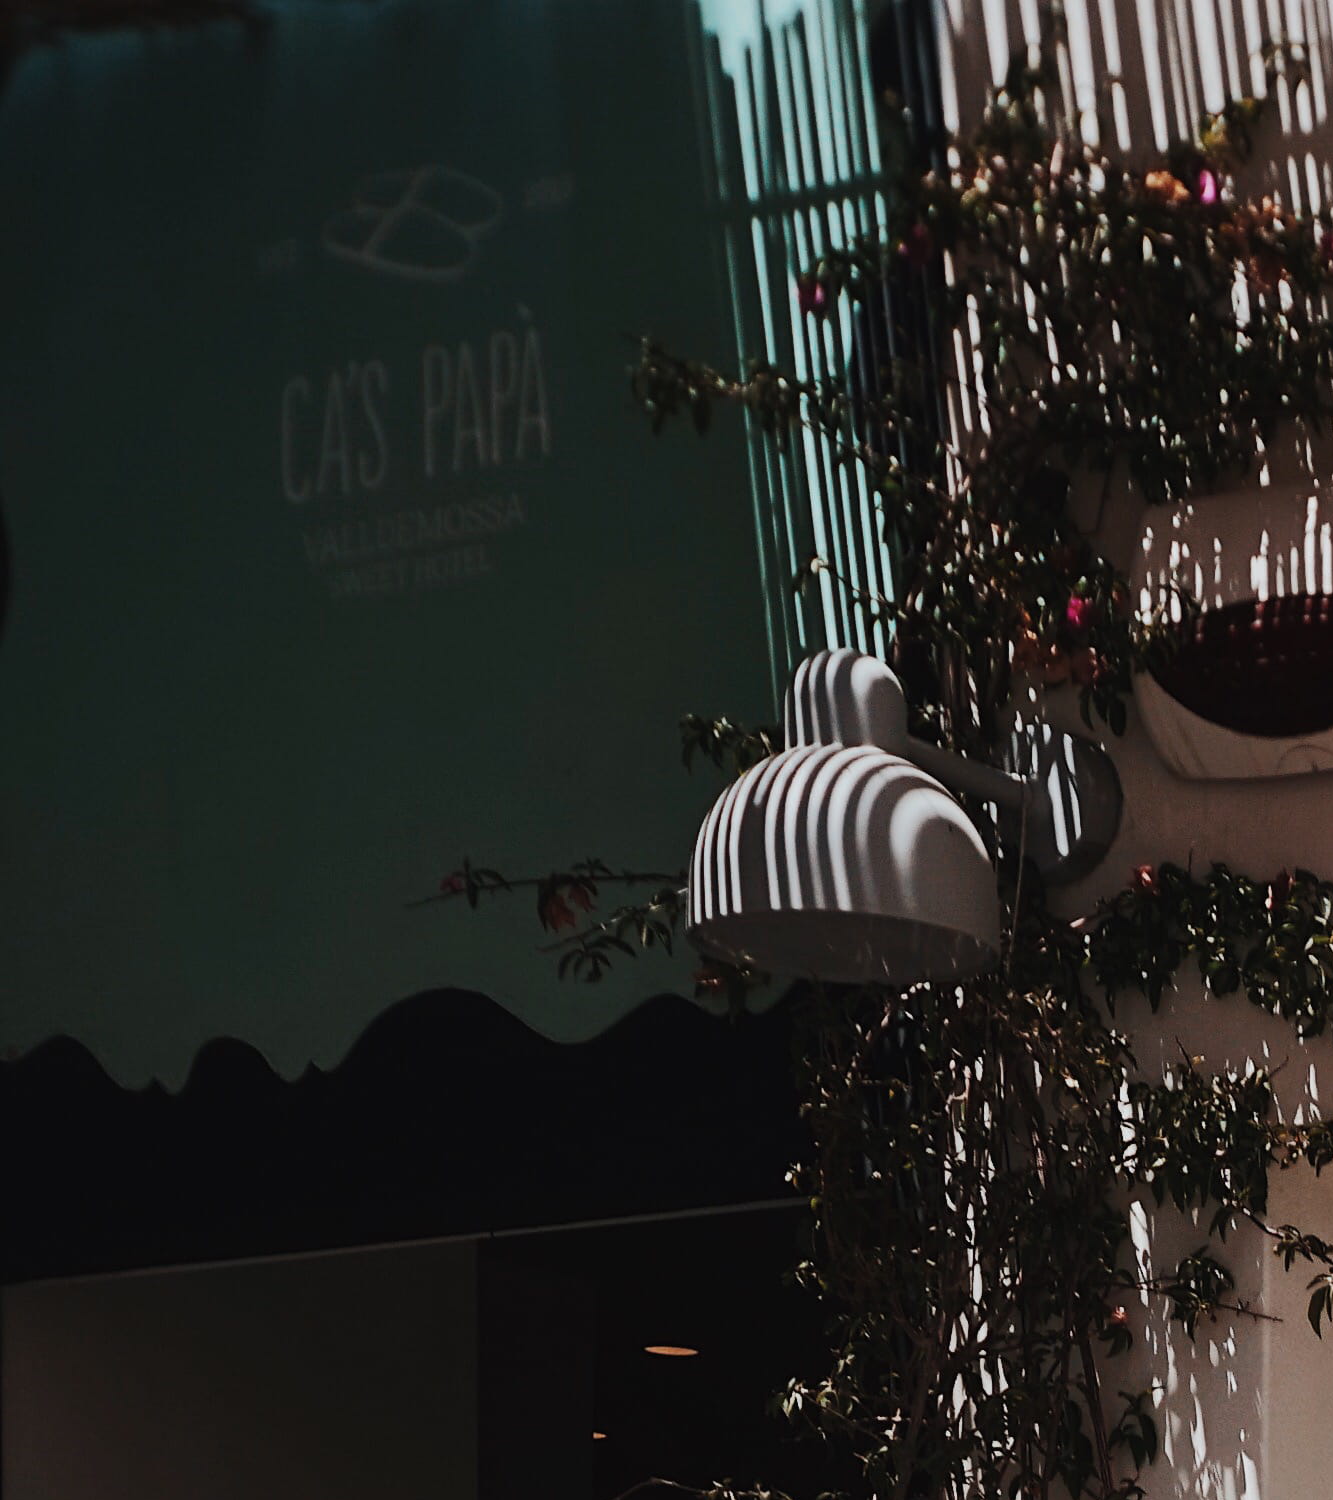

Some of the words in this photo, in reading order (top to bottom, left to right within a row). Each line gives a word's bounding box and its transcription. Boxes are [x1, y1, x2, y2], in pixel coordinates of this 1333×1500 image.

[280, 359, 390, 505] CA'S
[422, 300, 552, 478] PAPÀ
[301, 493, 526, 566] VALLDEMOSSA
[414, 544, 492, 582] HOTEL
